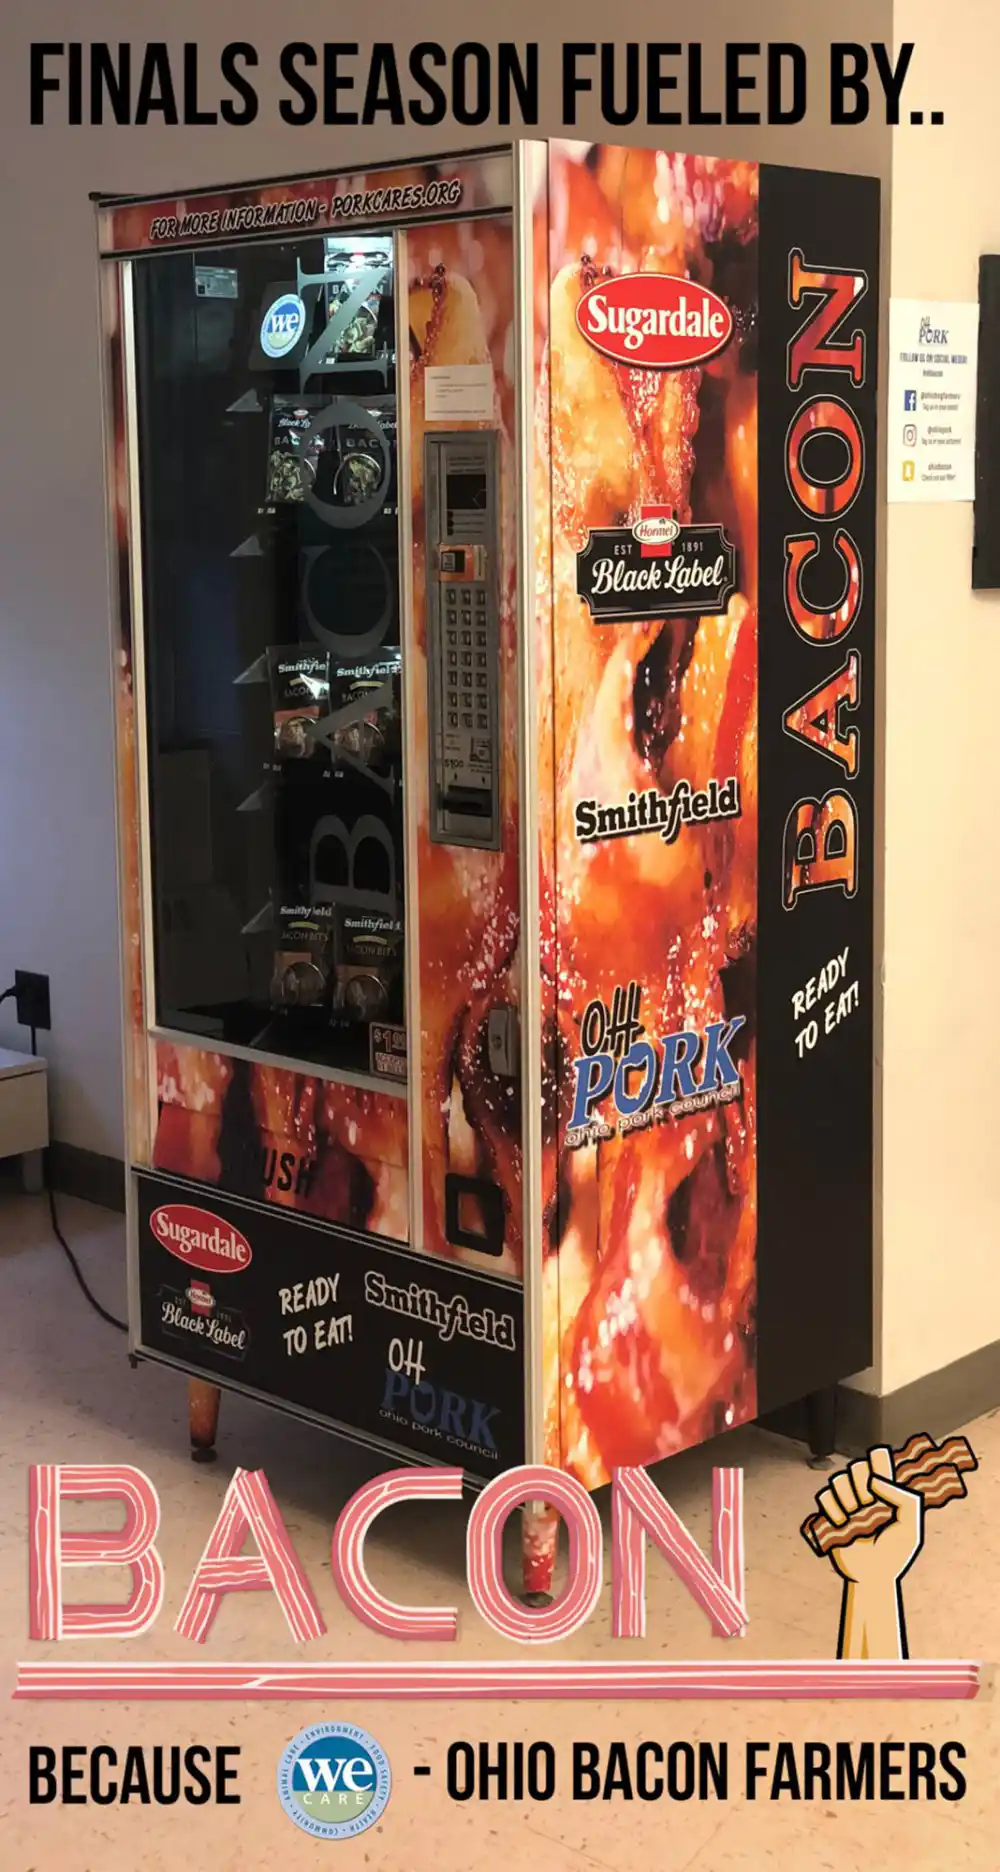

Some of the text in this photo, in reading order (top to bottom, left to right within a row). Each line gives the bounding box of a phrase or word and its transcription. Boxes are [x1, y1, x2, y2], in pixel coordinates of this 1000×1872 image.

[150, 217, 176, 240] FOR
[179, 211, 218, 237] MORE
[220, 197, 317, 231] INFORMATION
[331, 179, 462, 218] PORKCARES.ORG
[587, 294, 724, 350] Sugardale
[918, 328, 949, 344] PORK
[614, 542, 704, 555] EST 1891
[638, 524, 674, 537] Hormel
[591, 555, 725, 595] Black Label
[782, 248, 869, 911] BACON
[575, 776, 740, 842] Smithfield
[791, 946, 849, 1020] READY
[580, 979, 641, 1057] OH
[795, 980, 859, 1058] TO EAT!
[566, 1014, 746, 1130] PORK
[564, 1083, 741, 1148] ohio pork council
[156, 1211, 247, 1263] Sugardale
[278, 1272, 340, 1316] READY
[364, 1270, 516, 1351] Smithfield
[161, 1301, 246, 1350] Black Label
[283, 1313, 354, 1356] TO EAT!
[388, 1338, 426, 1385] OH
[378, 1408, 499, 1461] ohio pork council
[380, 1367, 502, 1449] PORK
